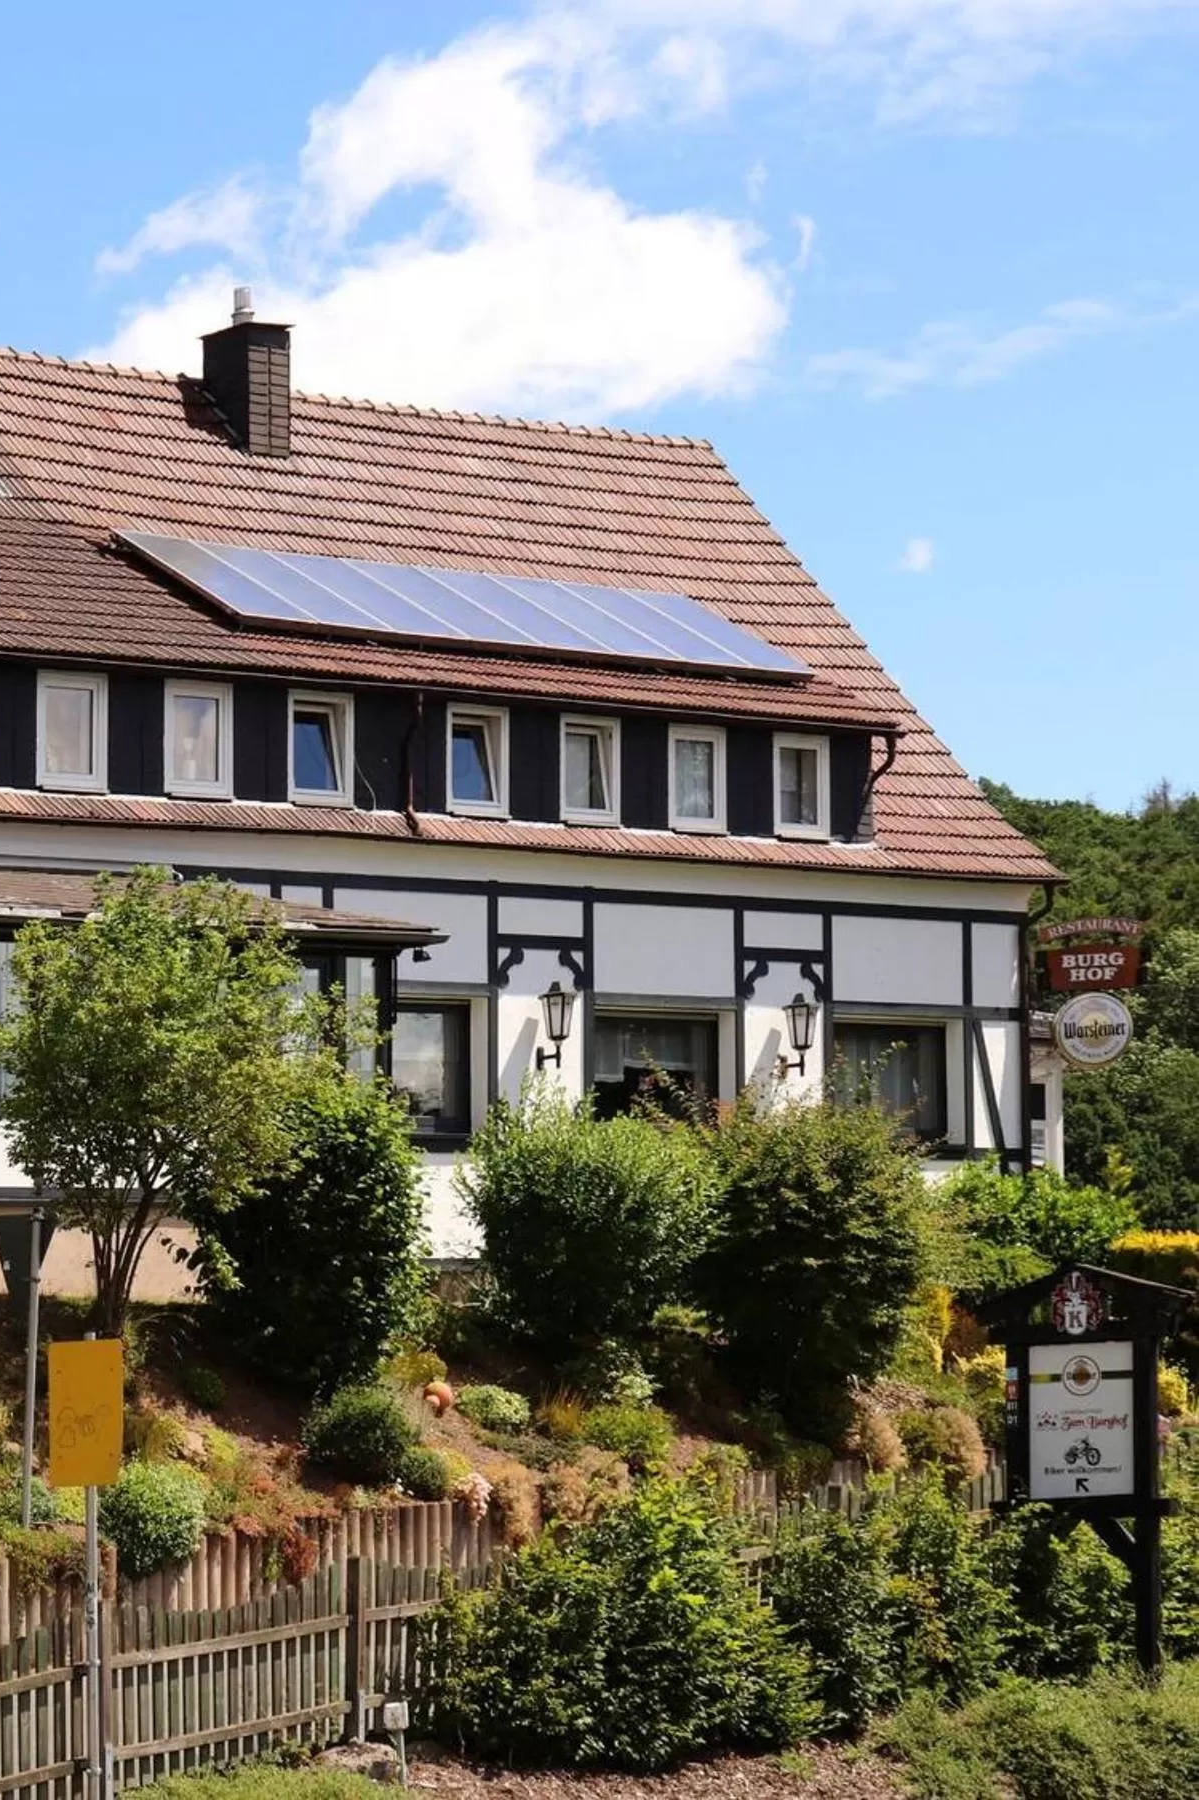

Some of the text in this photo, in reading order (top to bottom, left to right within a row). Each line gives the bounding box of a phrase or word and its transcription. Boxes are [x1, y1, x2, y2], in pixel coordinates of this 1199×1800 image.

[1048, 918, 1139, 938] RESTAURANT
[1061, 952, 1125, 967] BURG
[1069, 968, 1118, 981] HOF
[1064, 1020, 1126, 1040] Warsteiner
[1069, 1310, 1083, 1329] K
